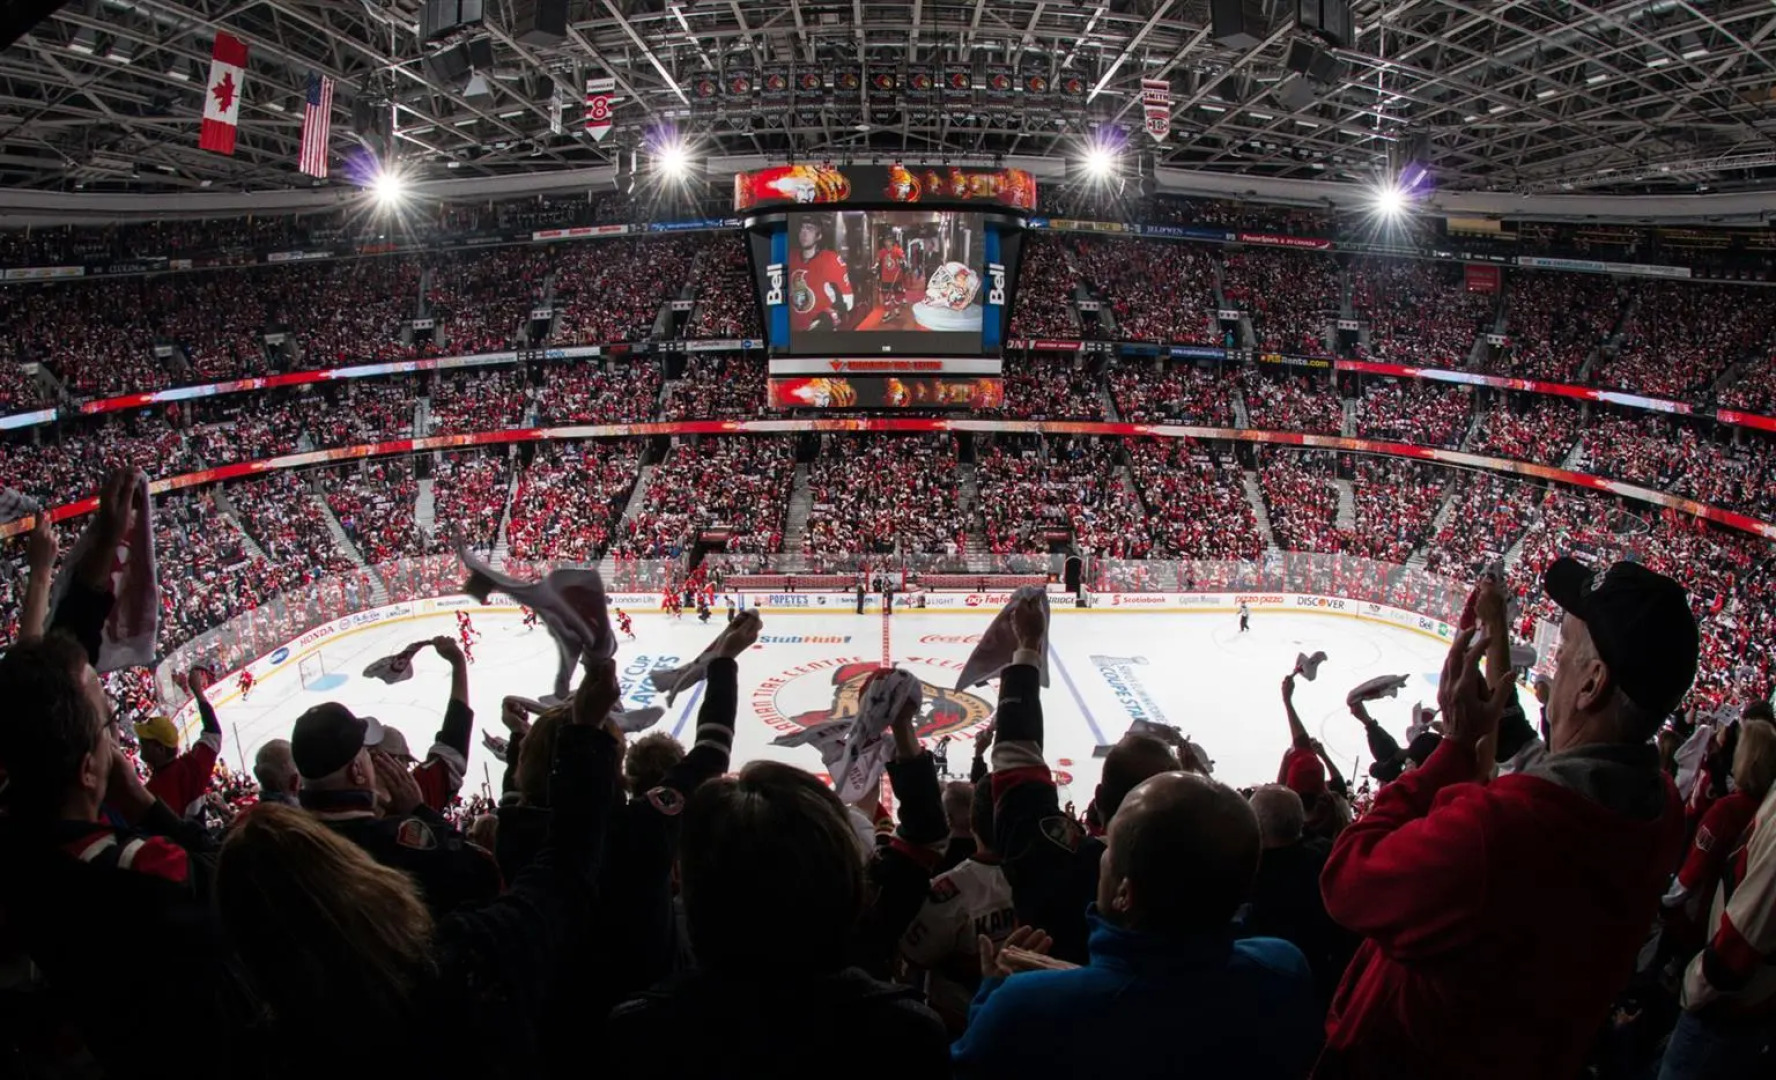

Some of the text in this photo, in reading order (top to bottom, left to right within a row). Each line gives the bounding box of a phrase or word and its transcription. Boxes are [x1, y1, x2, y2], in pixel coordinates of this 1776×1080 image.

[591, 96, 608, 120] 8
[767, 263, 783, 305] Bell
[989, 263, 1005, 305] Bell
[615, 596, 642, 604] London
[1123, 595, 1166, 604] Scotiabank
[1297, 596, 1345, 609] DISCOVER
[300, 626, 335, 648] HONDA
